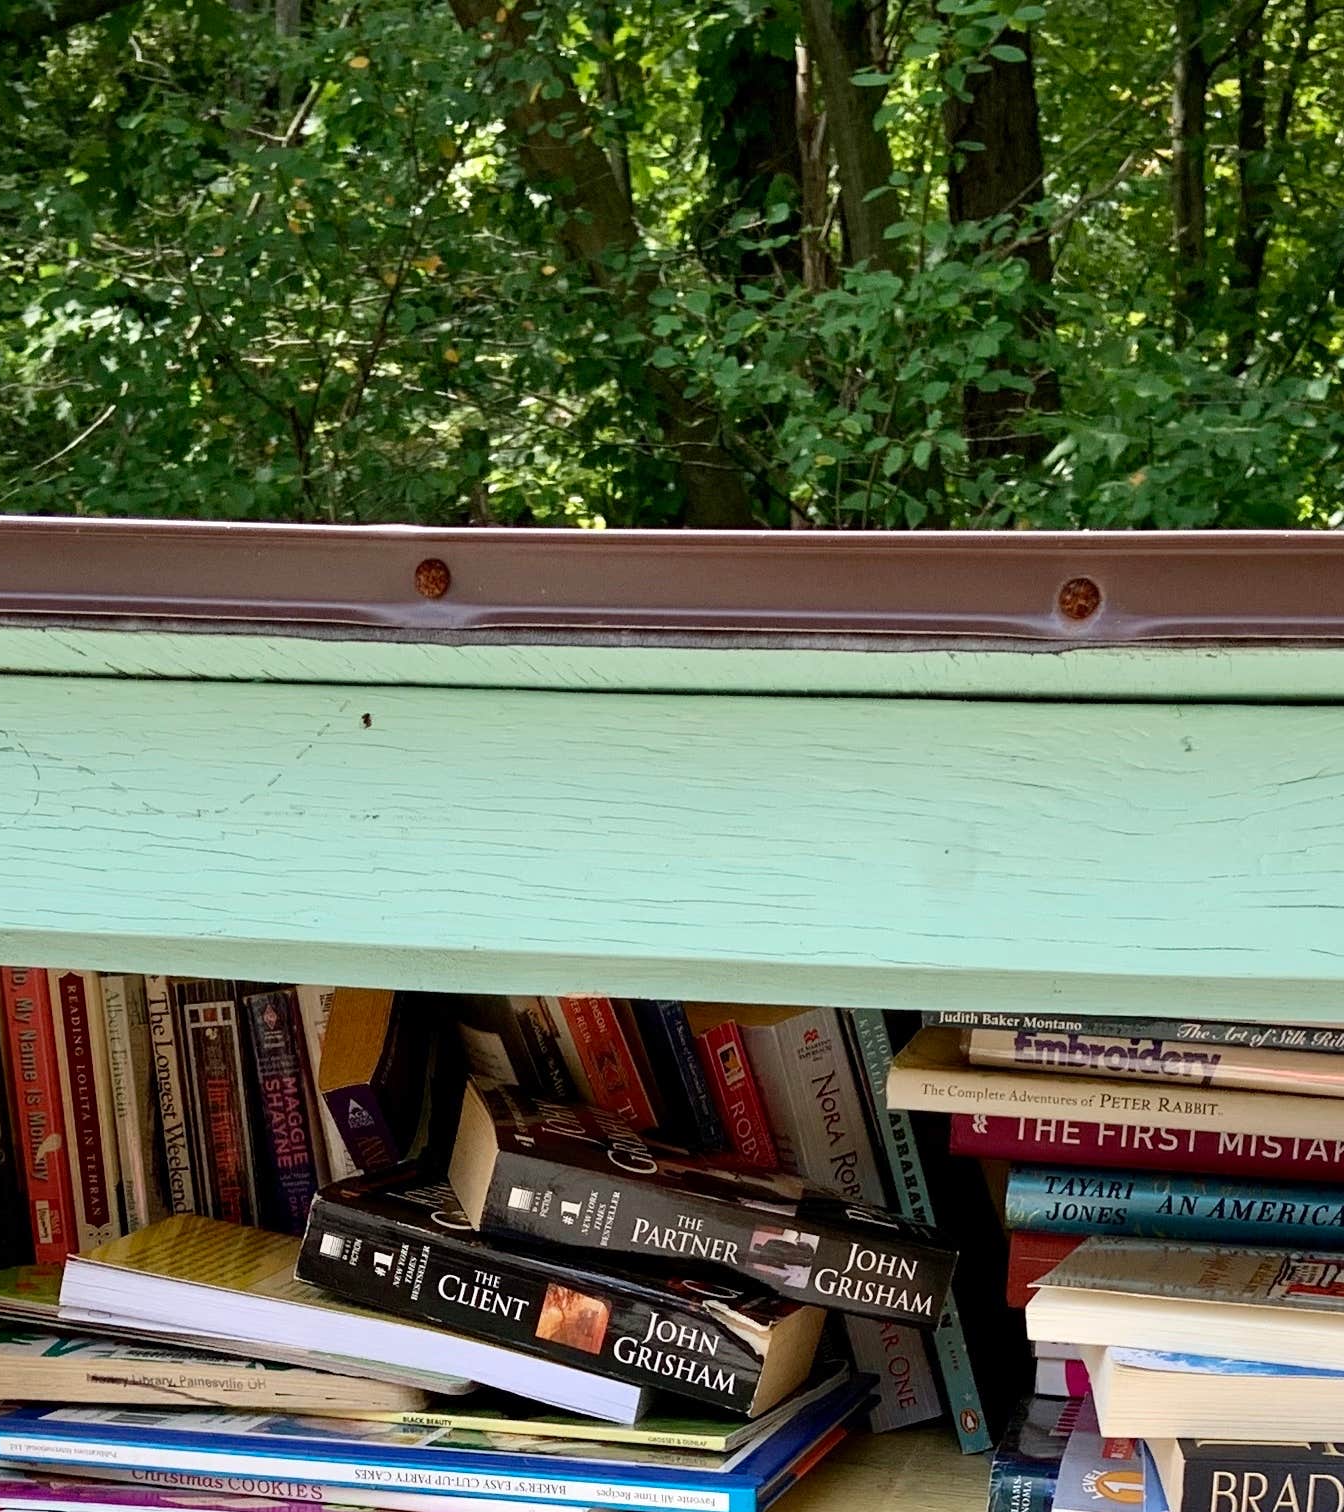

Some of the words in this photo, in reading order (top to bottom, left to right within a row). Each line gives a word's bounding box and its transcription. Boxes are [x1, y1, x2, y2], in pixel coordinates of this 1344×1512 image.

[67, 985, 83, 1057] READING
[148, 993, 172, 1037] The
[939, 1011, 978, 1027] Judith
[983, 1014, 1020, 1028] Baker
[1023, 1017, 1082, 1031] Montano
[1177, 1024, 1210, 1040] The
[1214, 1027, 1247, 1043] Art
[1251, 1028, 1270, 1047] of
[1274, 1031, 1307, 1047] Silk
[1014, 1032, 1221, 1085] Embroidery
[154, 1040, 178, 1119] Longest
[76, 1065, 92, 1120] LOLITA
[923, 1083, 944, 1097] The
[947, 1086, 1005, 1103] Complete
[1009, 1090, 1079, 1107] Adventures
[1082, 1094, 1094, 1107] of
[1099, 1094, 1151, 1111] PETER
[1158, 1098, 1218, 1116] RABBIT
[282, 1077, 308, 1163] MAGGIE
[812, 1071, 845, 1146] NORA
[265, 1078, 291, 1167] SHAYNE
[1016, 1118, 1081, 1144] THE
[1097, 1123, 1196, 1152] FIRST
[83, 1128, 95, 1145] IN
[161, 1122, 193, 1214] Weekend
[86, 1152, 102, 1216] TEHRAN
[1045, 1176, 1134, 1200] TAYARI
[562, 1200, 582, 1225] #1
[1045, 1202, 1127, 1225] JONES
[1157, 1196, 1200, 1215] AN
[677, 1214, 704, 1233] THE
[631, 1218, 738, 1264] PARTNER
[374, 1251, 394, 1277] #1
[844, 1243, 920, 1280] JOHN
[474, 1270, 500, 1290] THE
[814, 1268, 933, 1316] GRISHAM
[437, 1274, 530, 1321] CLIENT
[644, 1313, 720, 1356] JOHN
[613, 1337, 736, 1395] GRISHAM
[402, 1416, 424, 1426] BLACK
[426, 1417, 452, 1426] BEAUTY
[354, 1469, 391, 1482] CAKES
[395, 1472, 431, 1485] PARTY
[435, 1475, 480, 1489] CUT-UP
[484, 1479, 511, 1492] EASY
[228, 1478, 323, 1499] COOKIES
[596, 1488, 631, 1500] Recipes
[634, 1491, 658, 1502] Time
[661, 1494, 674, 1505] All
[677, 1495, 716, 1507] Favorite
